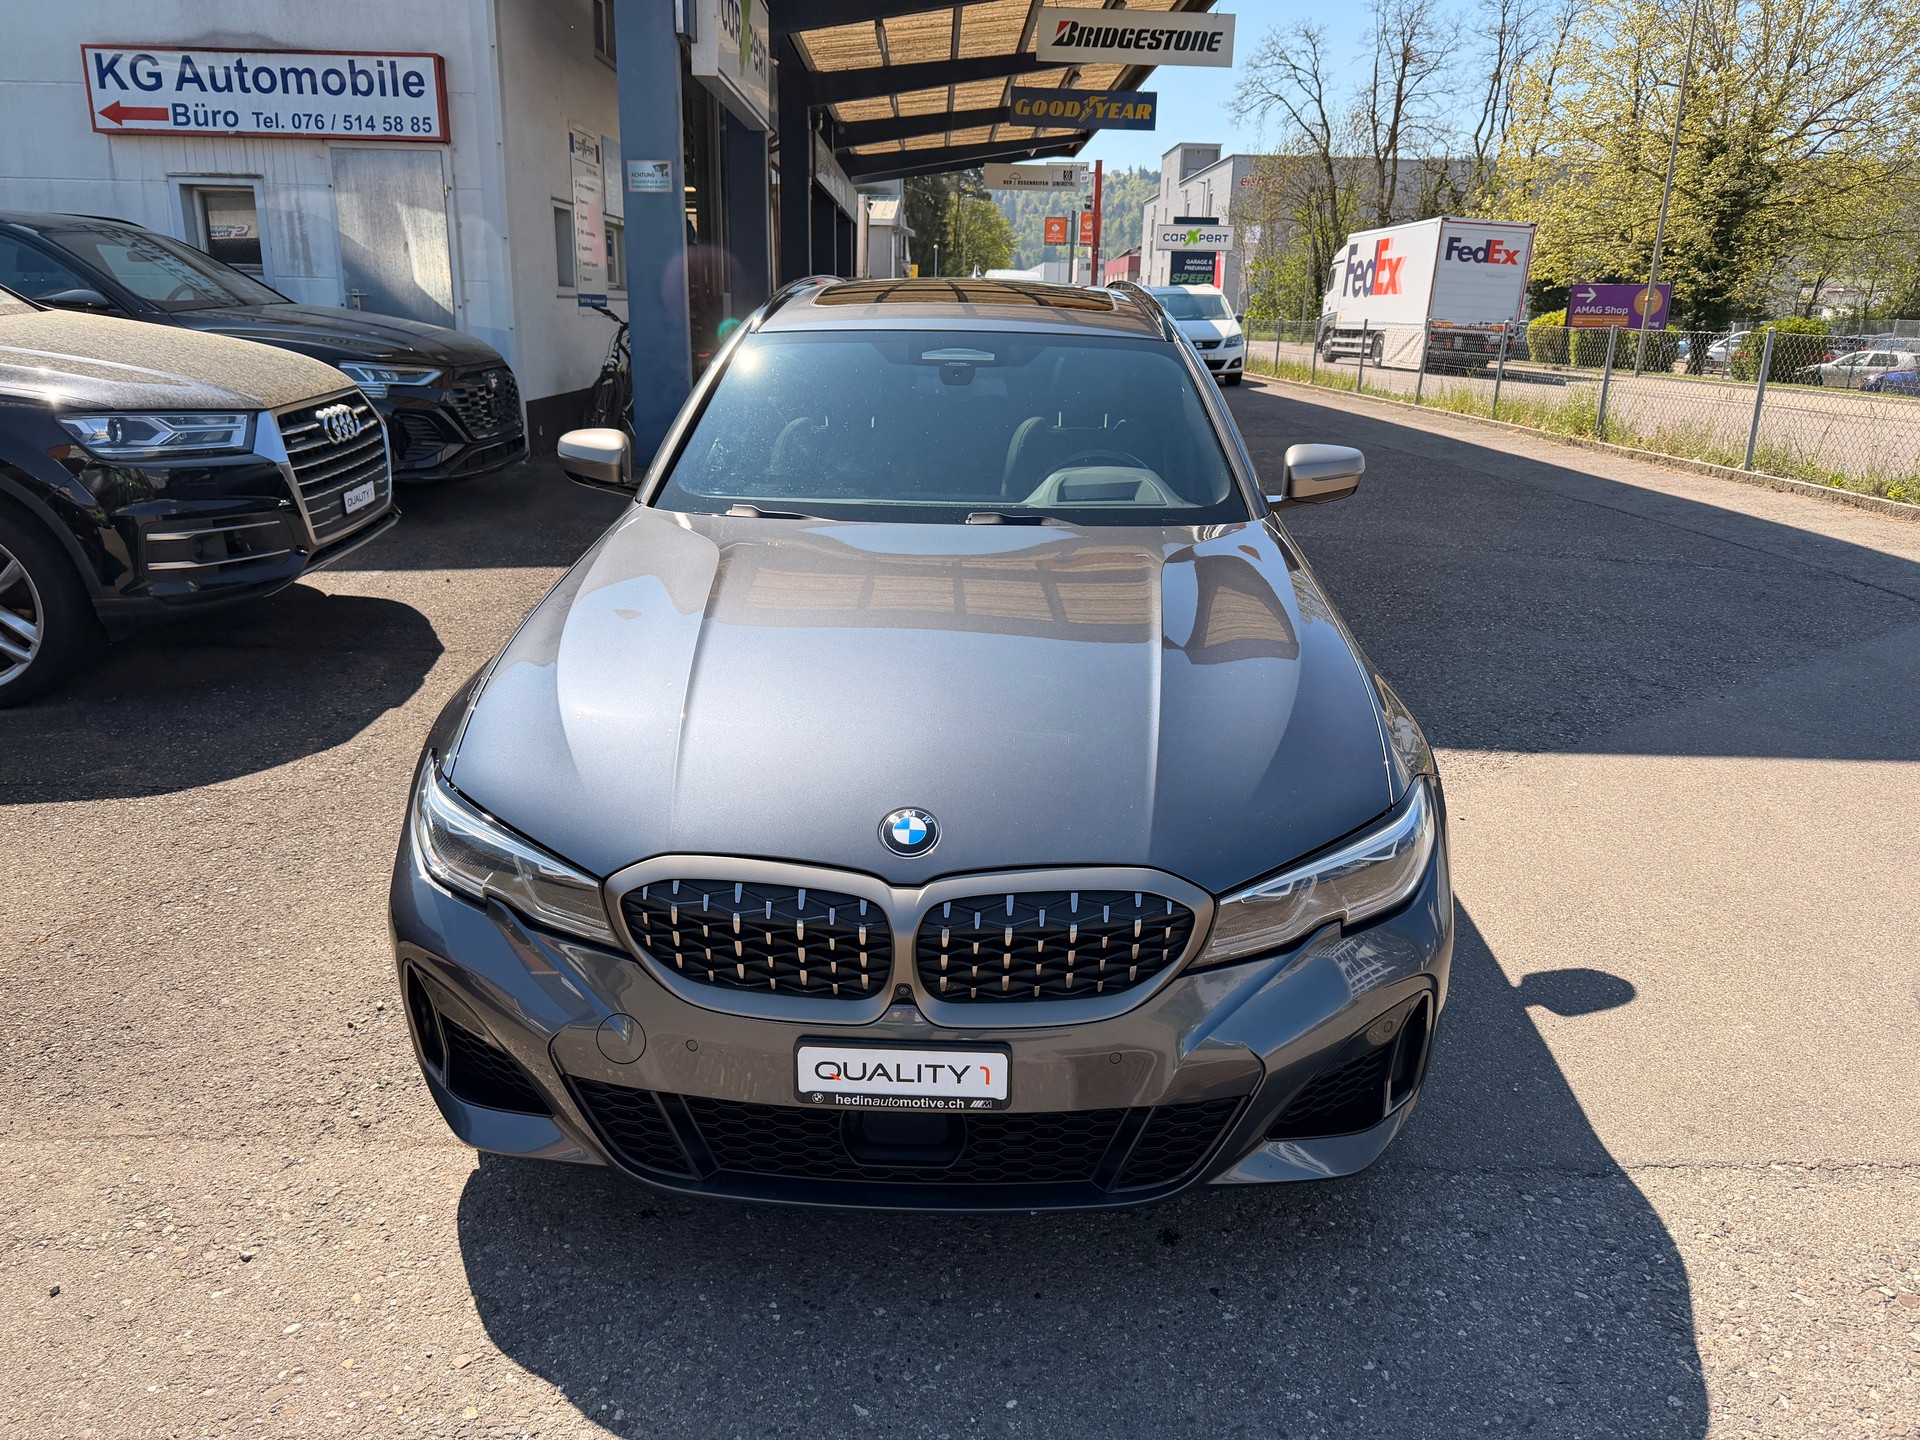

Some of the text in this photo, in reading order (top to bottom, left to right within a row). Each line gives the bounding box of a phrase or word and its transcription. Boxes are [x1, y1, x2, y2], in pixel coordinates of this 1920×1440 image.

[1051, 20, 1224, 53] BRIDGESTONE
[94, 52, 425, 98] KG Automobile
[171, 102, 432, 133] Büro Tel. 076 / 514 58 85
[1445, 236, 1520, 266] FedEx
[1171, 273, 1214, 283] SPEED
[1343, 237, 1408, 298] FedEx
[1574, 306, 1629, 315] AMAG Shop
[347, 489, 370, 507] QUALITY
[814, 1061, 990, 1085] QUALITY 1
[835, 1094, 965, 1109] hedinautomotive.ch
